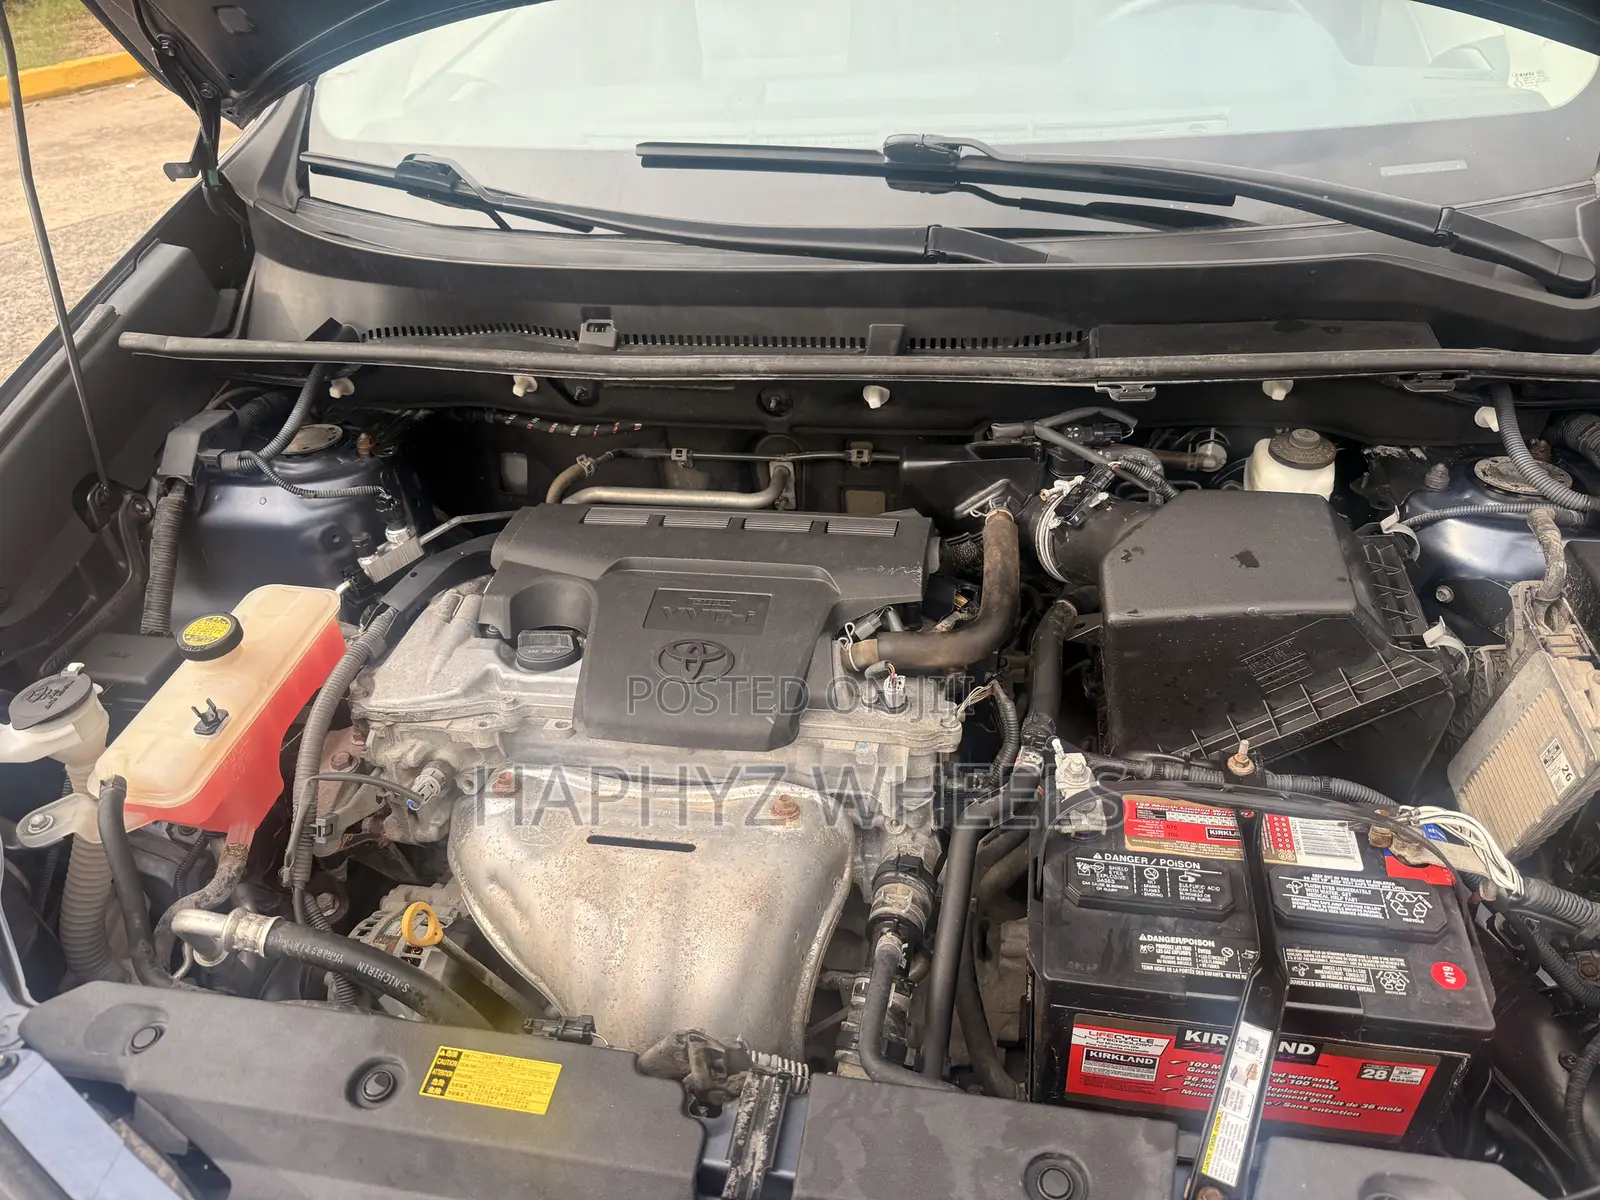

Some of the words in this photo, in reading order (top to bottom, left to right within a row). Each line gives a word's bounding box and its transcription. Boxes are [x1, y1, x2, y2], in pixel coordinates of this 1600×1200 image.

[1104, 853, 1149, 865] DANGER
[1159, 858, 1201, 869] POISON
[1442, 966, 1457, 985] 4/19
[1088, 1030, 1155, 1044] LIFECYCLE
[1089, 1050, 1154, 1065] KIRKLAND
[1188, 1061, 1210, 1069] 100
[1288, 1073, 1339, 1085] warranty
[1361, 1068, 1388, 1080] 28
[1283, 1102, 1310, 1110] Sans
[1311, 1106, 1361, 1117] entretien
